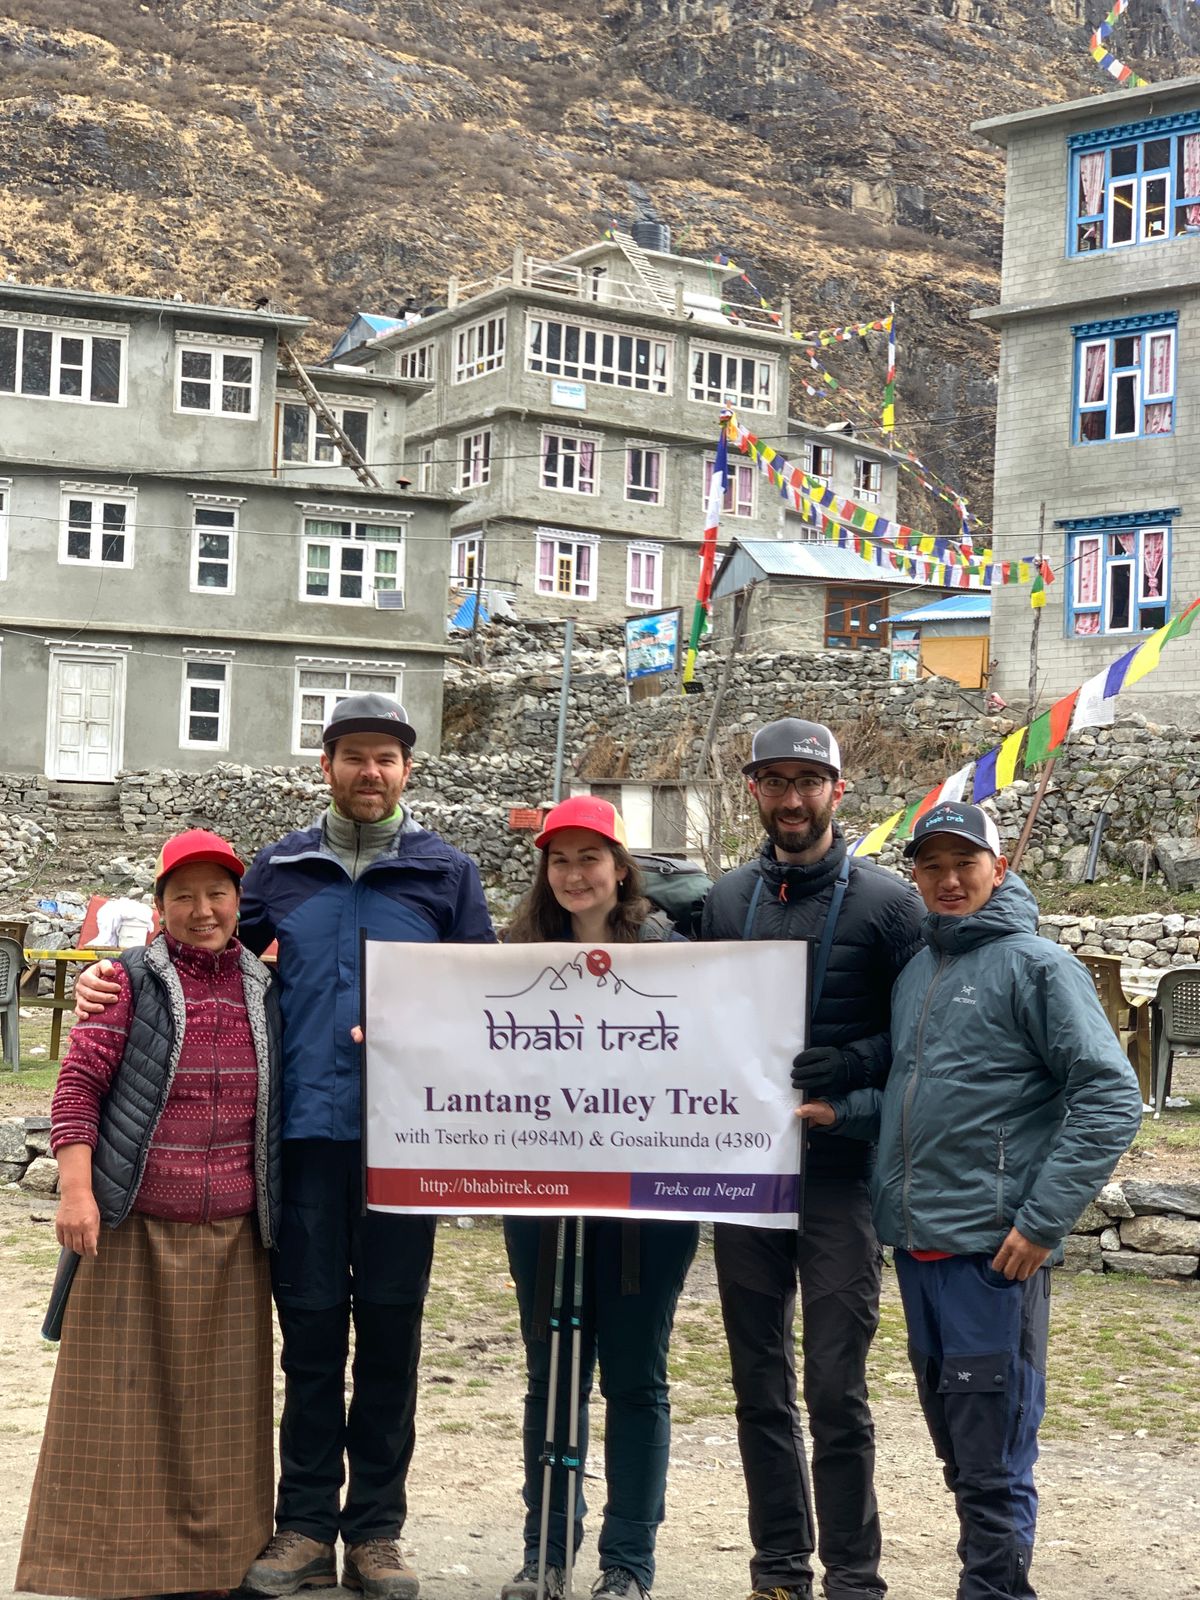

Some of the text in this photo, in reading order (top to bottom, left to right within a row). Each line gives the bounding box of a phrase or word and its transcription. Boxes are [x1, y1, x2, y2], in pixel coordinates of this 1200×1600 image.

[483, 1009, 680, 1051] bhabi trek
[424, 1086, 741, 1122] Lantang Valley Trek
[395, 1128, 772, 1152] with Tserko ri (4984M) & Gosaikunda (4380)
[420, 1177, 569, 1197] http://bhabitrek.com
[653, 1181, 757, 1200] Treks au Nepal
